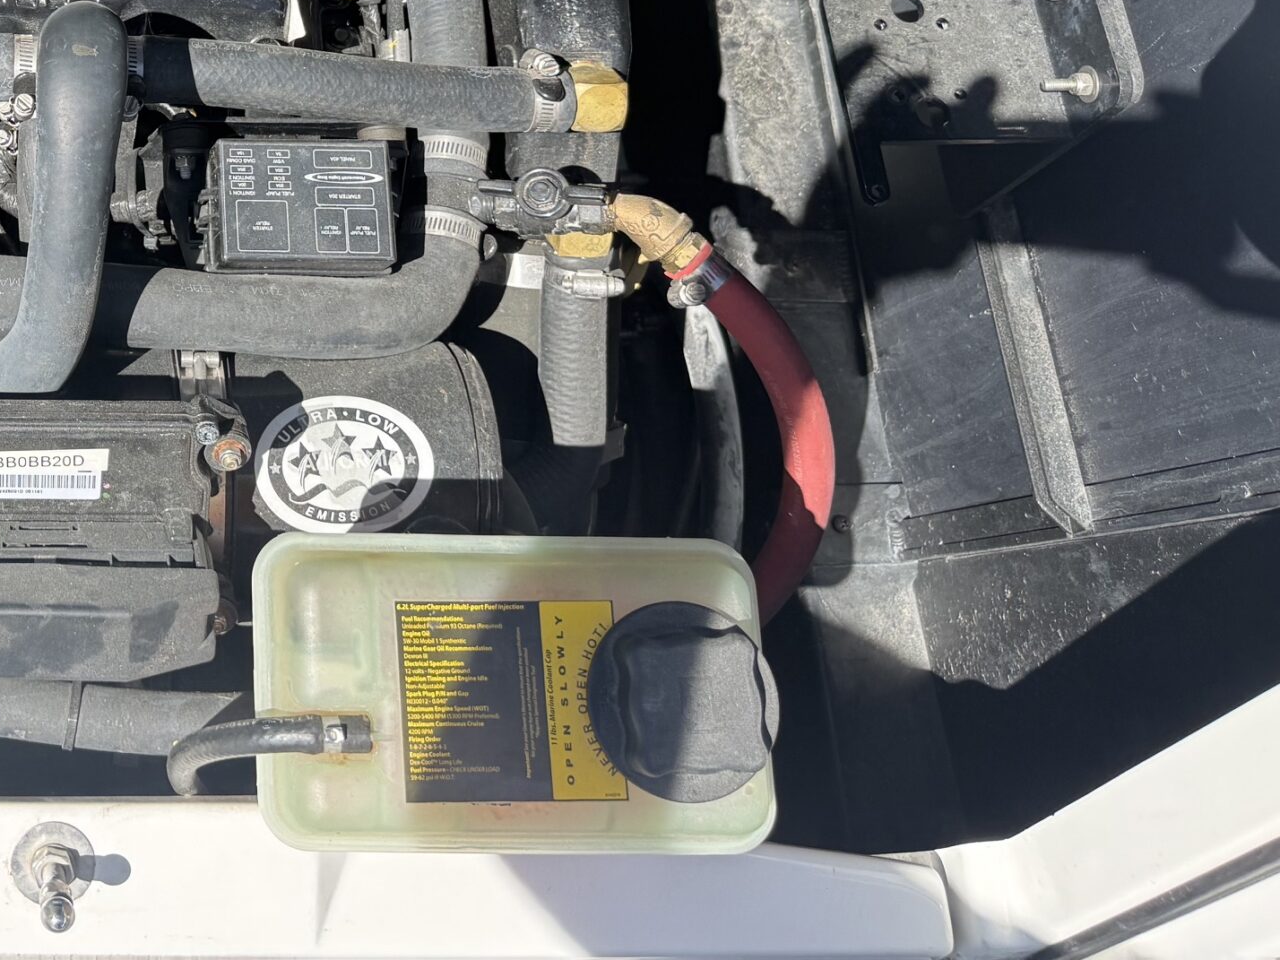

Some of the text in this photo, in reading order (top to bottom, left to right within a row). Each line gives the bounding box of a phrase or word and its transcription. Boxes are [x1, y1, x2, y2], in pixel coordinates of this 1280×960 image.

[278, 408, 399, 443] ULTRA LOW
[305, 502, 390, 523] EMISSION
[546, 665, 554, 694] Coolant
[576, 667, 588, 714] OPEN
[548, 696, 556, 722] Marine
[555, 616, 576, 785] OPEN SLOWLY
[583, 724, 618, 776] NEVER
